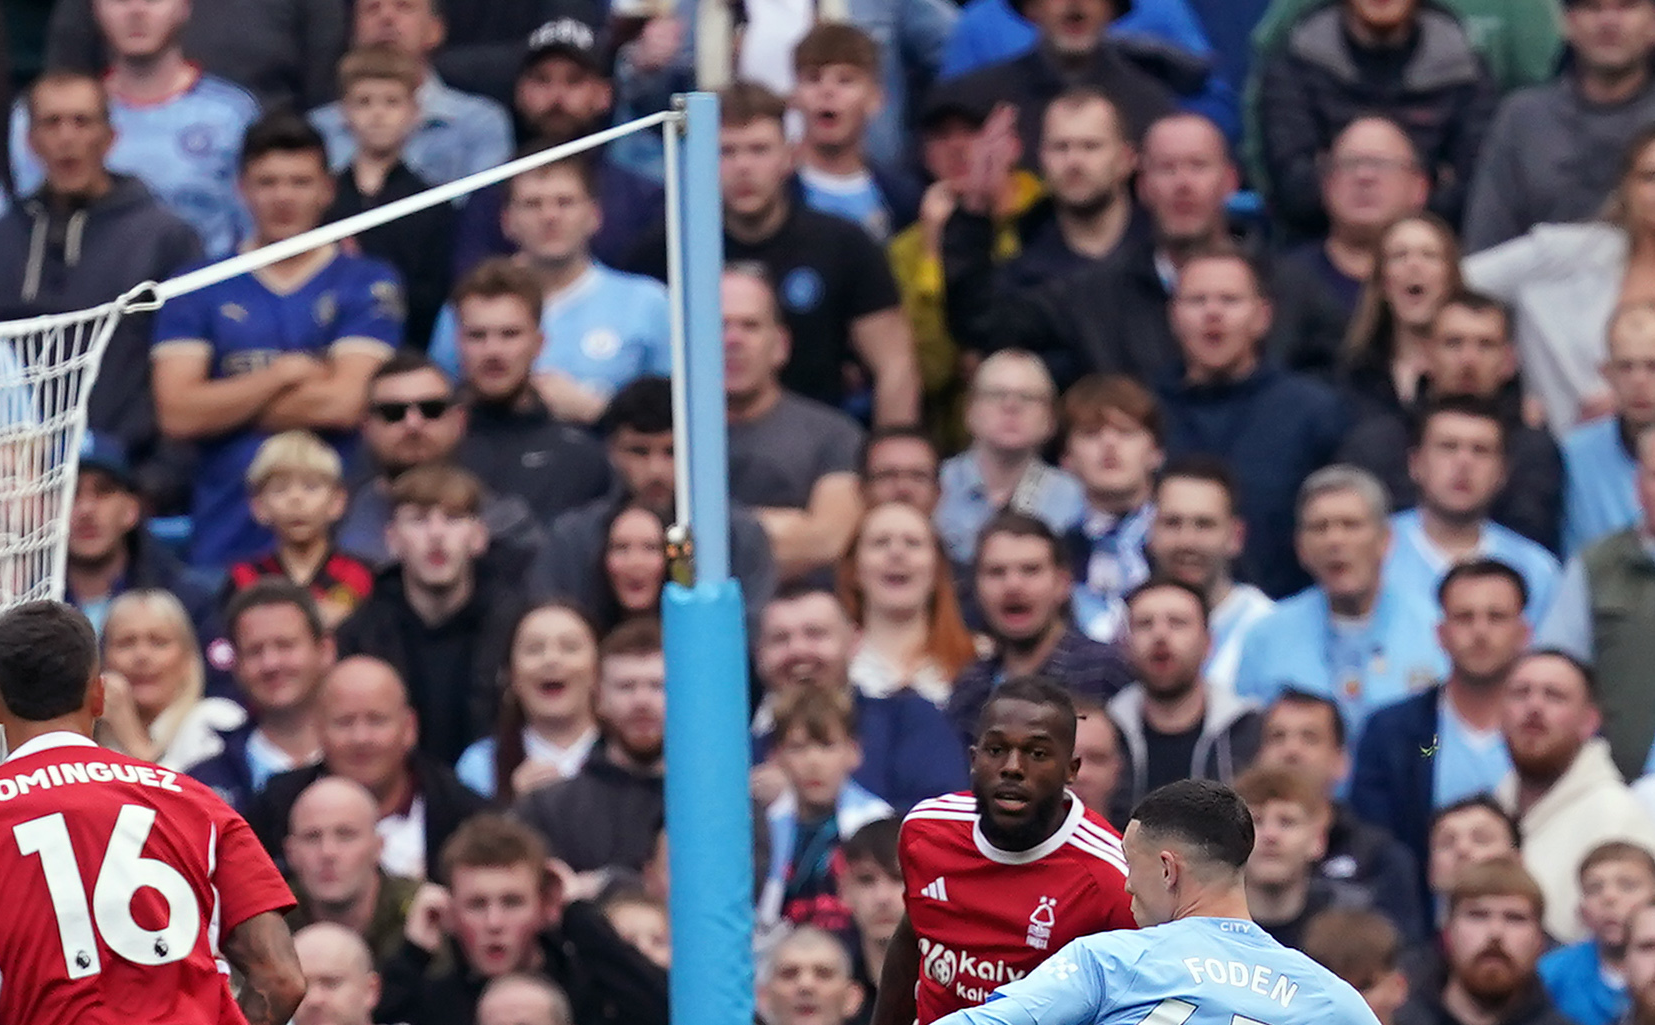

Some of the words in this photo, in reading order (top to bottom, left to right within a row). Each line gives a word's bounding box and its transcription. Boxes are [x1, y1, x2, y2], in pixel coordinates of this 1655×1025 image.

[12, 803, 200, 980] 16
[1219, 921, 1251, 934] CITY
[1182, 956, 1300, 1009] FODEN
